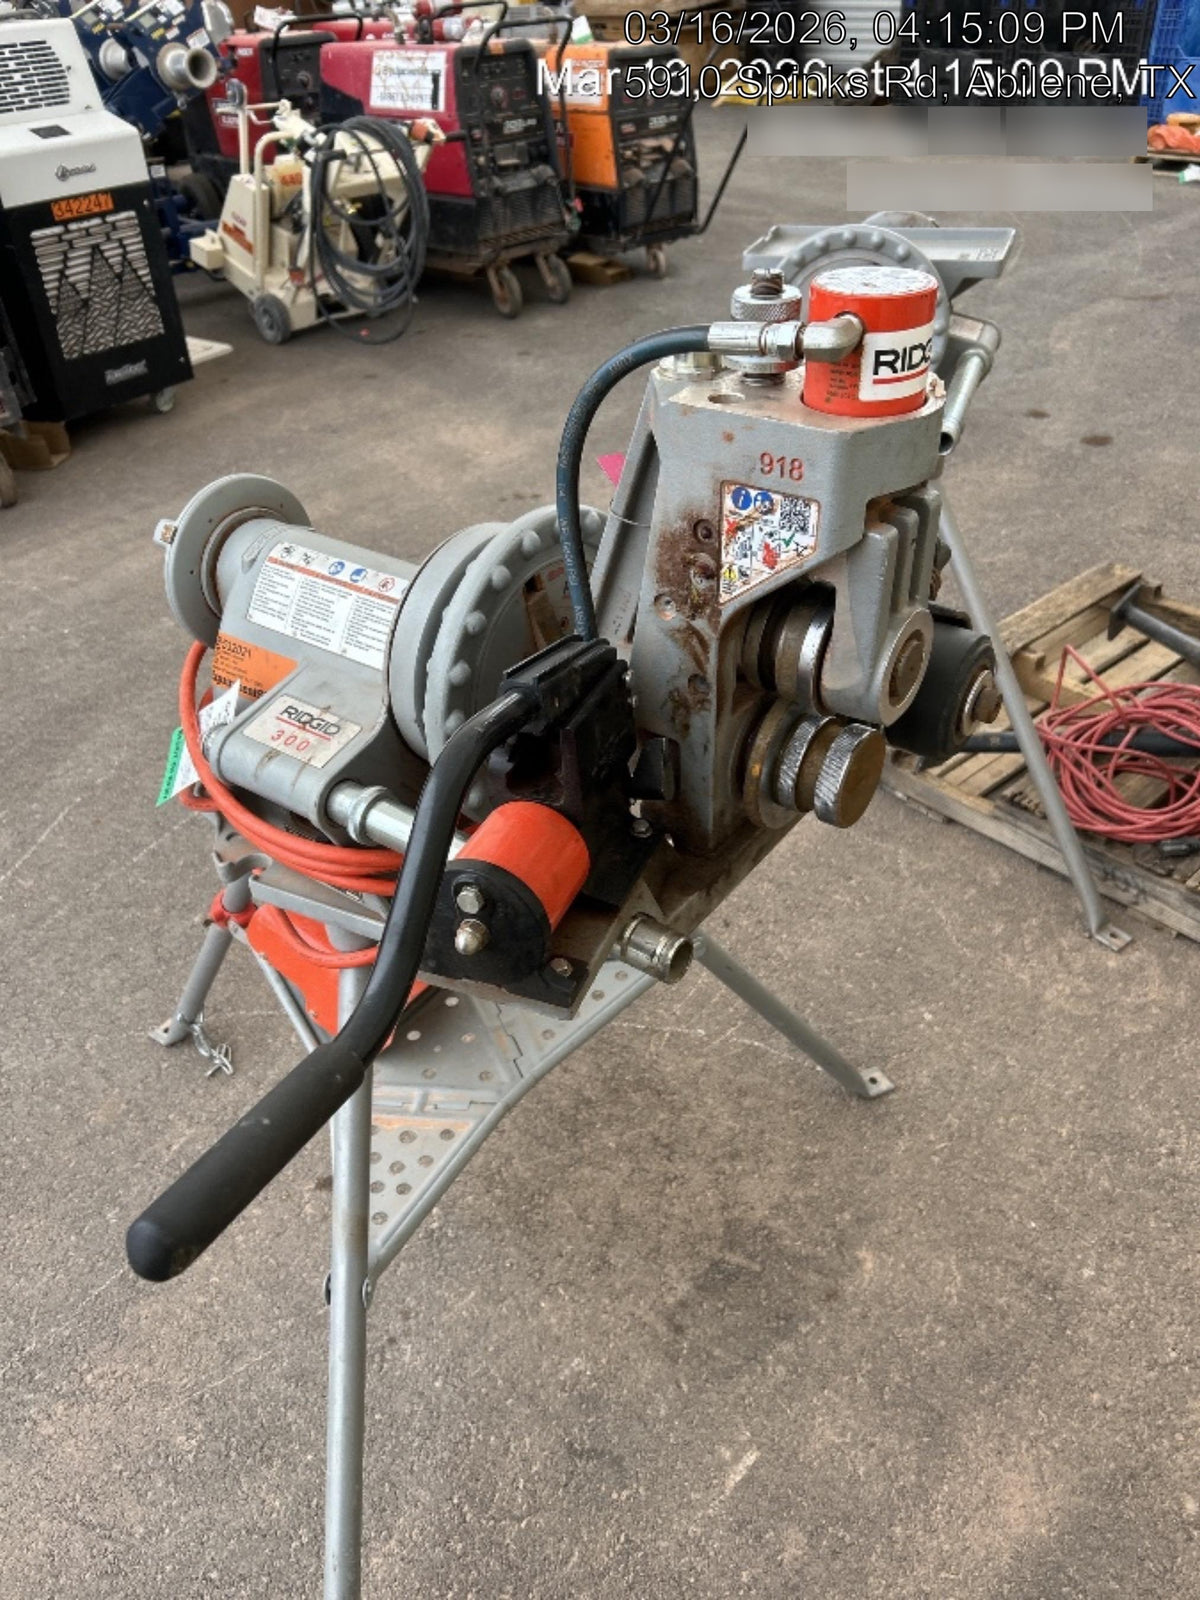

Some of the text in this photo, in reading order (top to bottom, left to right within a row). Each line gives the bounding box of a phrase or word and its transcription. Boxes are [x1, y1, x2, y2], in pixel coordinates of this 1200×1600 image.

[760, 451, 804, 481] 918
[279, 704, 341, 736] RIDGID
[271, 729, 310, 752] 300
